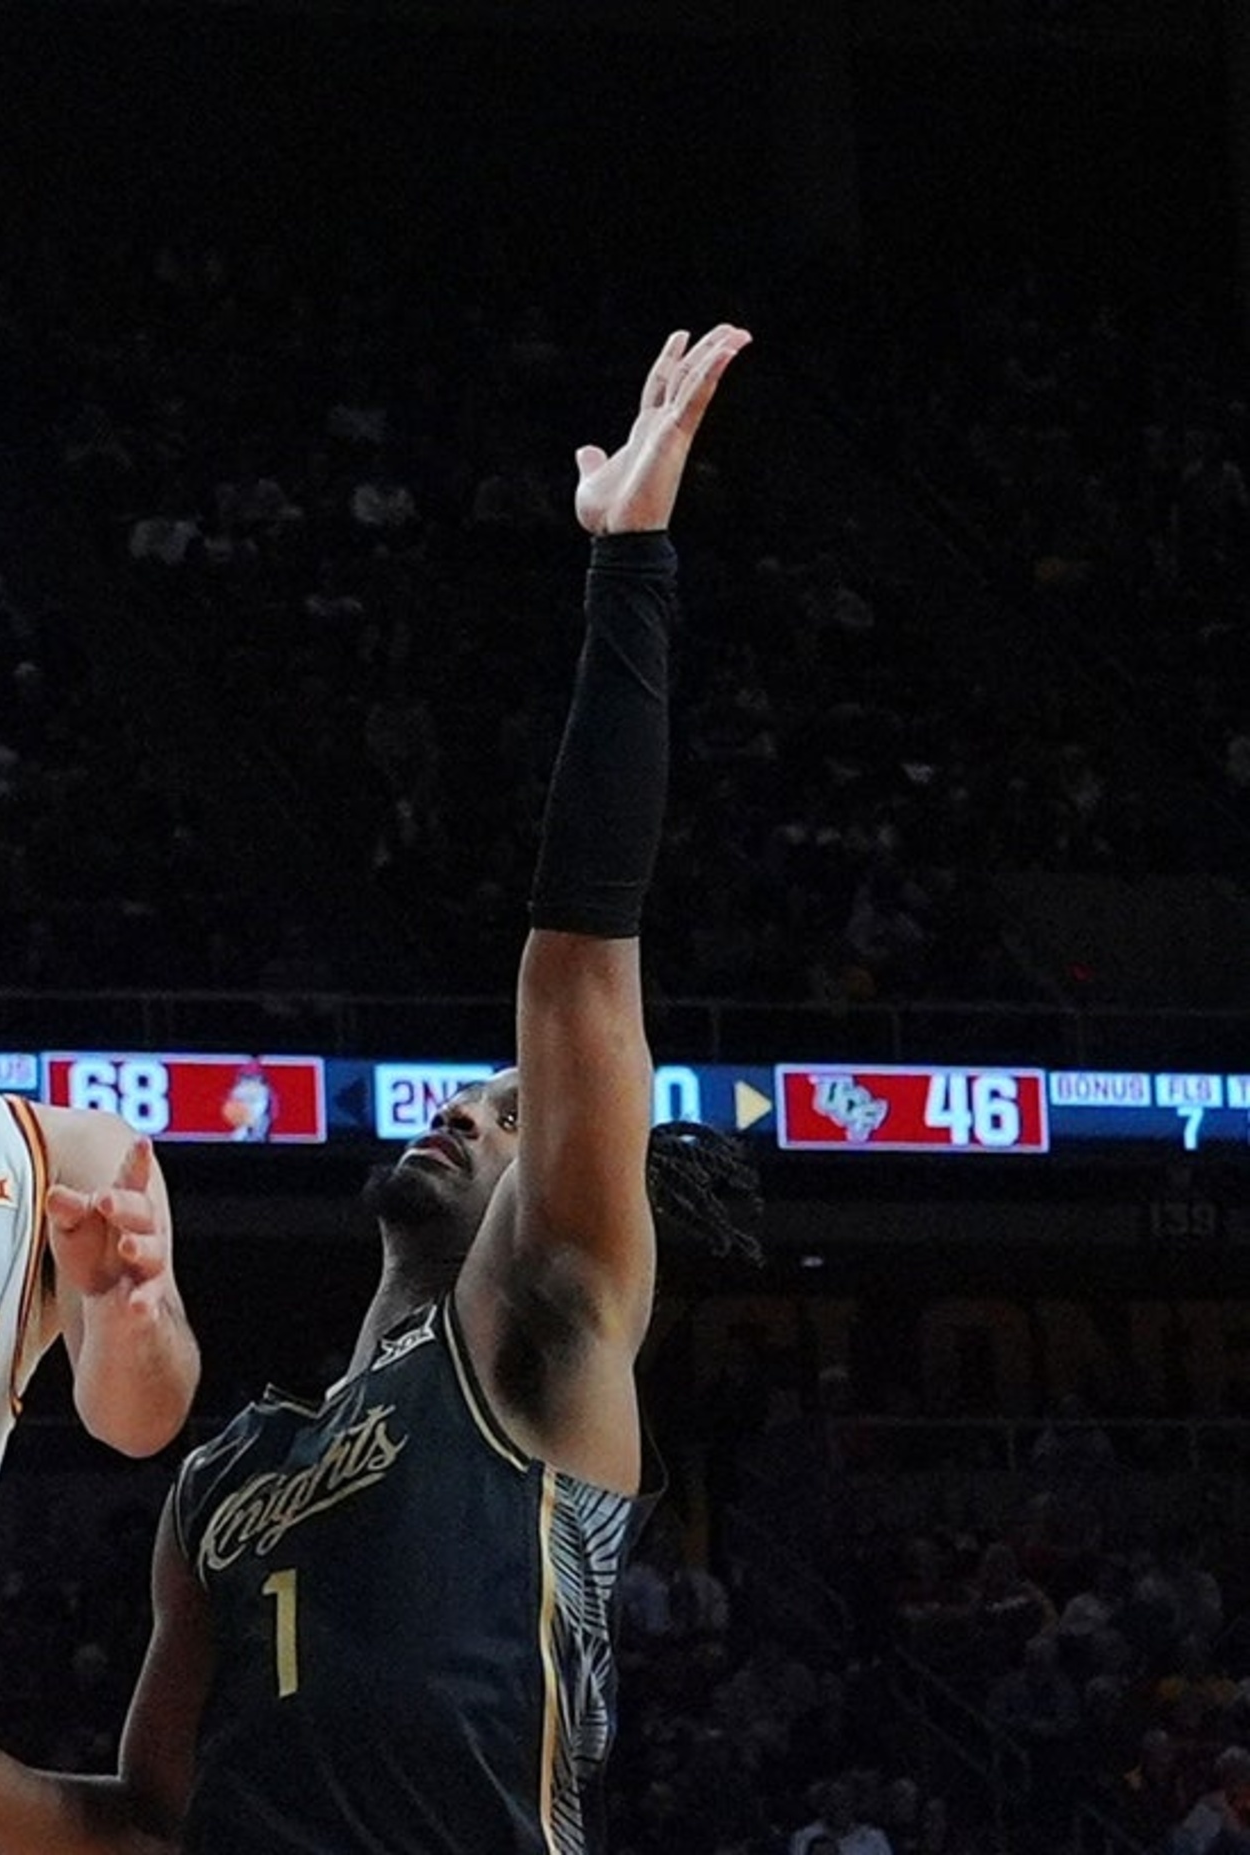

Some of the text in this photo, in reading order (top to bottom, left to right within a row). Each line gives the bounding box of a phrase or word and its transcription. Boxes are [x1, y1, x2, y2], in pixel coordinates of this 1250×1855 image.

[69, 1056, 169, 1136] 68
[391, 1079, 462, 1124] 2N
[924, 1073, 1021, 1147] 46
[1056, 1072, 1146, 1101] BONUS
[1177, 1106, 1204, 1150] 7
[262, 1567, 299, 1699] 1
